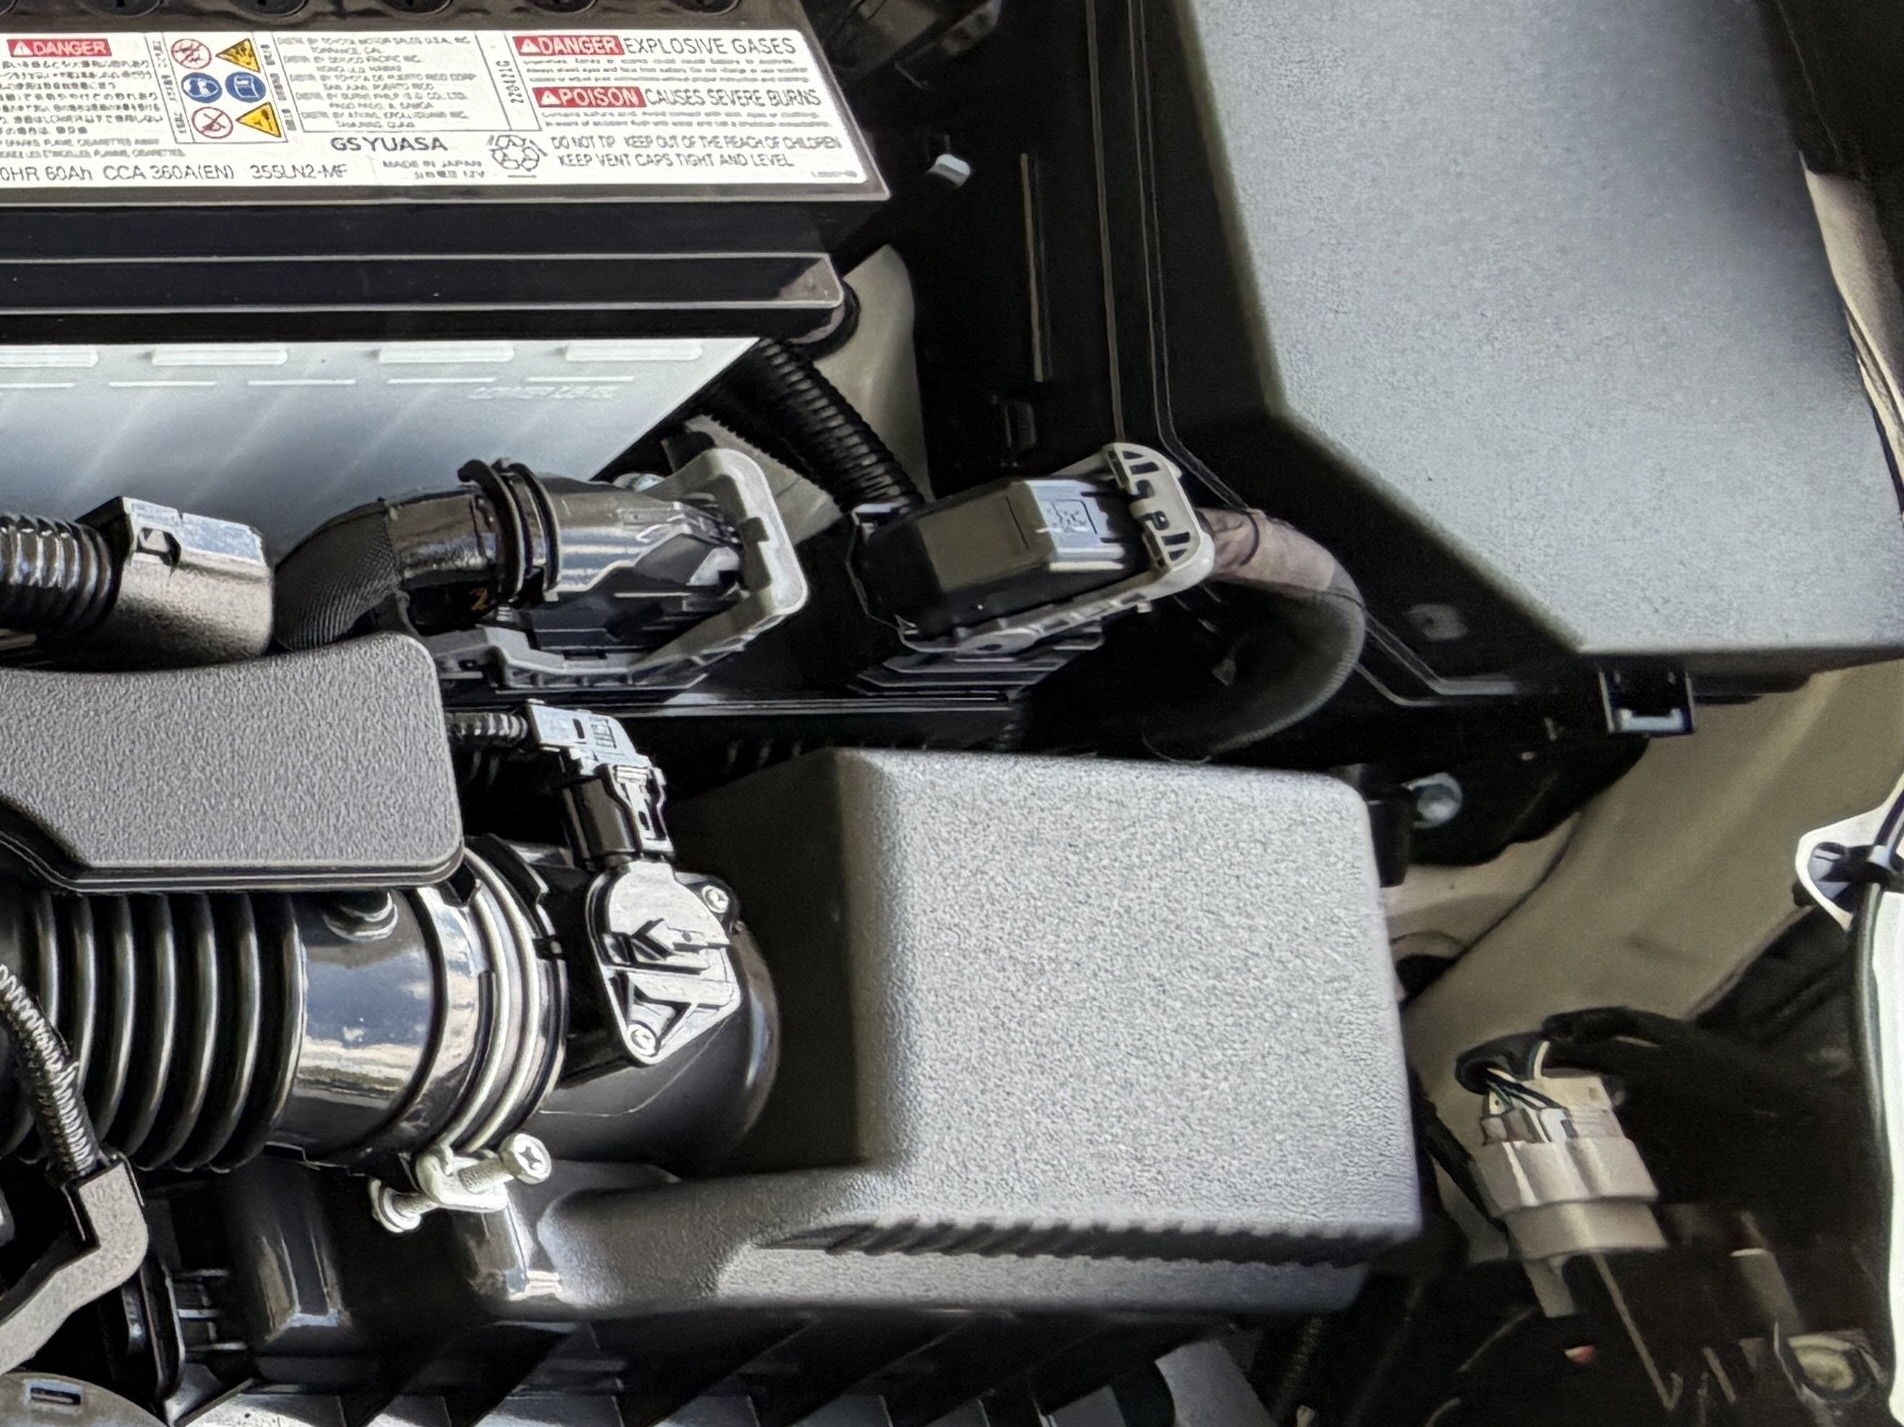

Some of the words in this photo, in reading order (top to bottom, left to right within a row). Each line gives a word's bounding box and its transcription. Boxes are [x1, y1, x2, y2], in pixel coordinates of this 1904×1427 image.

[32, 40, 107, 56] DANGER
[539, 37, 620, 54] DANGER
[623, 38, 728, 55] EXPLOSIVE
[733, 38, 797, 54] GASES
[559, 88, 639, 107] POISON
[645, 89, 705, 106] CAUSES
[707, 88, 767, 107] SEVERE
[769, 89, 822, 107] BURNS
[551, 136, 569, 149] DO
[571, 135, 595, 149] NOT
[598, 135, 615, 148] TIP
[624, 135, 653, 148] KEEP
[656, 136, 679, 149] OUT
[681, 135, 696, 149] OF
[698, 136, 723, 149] THE
[724, 136, 765, 150] REACH
[765, 136, 780, 150] OF
[782, 136, 842, 150] CHILDREN
[557, 154, 592, 167] KEEP
[596, 153, 631, 167] VENT
[635, 154, 673, 167] CAPS
[675, 153, 714, 167] TIGHT
[719, 154, 748, 167] AND
[750, 153, 794, 167] LEVEL
[45, 164, 93, 181] 60Ah
[102, 164, 146, 181] CCA
[153, 164, 235, 181] 360A(EN)
[249, 163, 349, 180] 355LN2-MF
